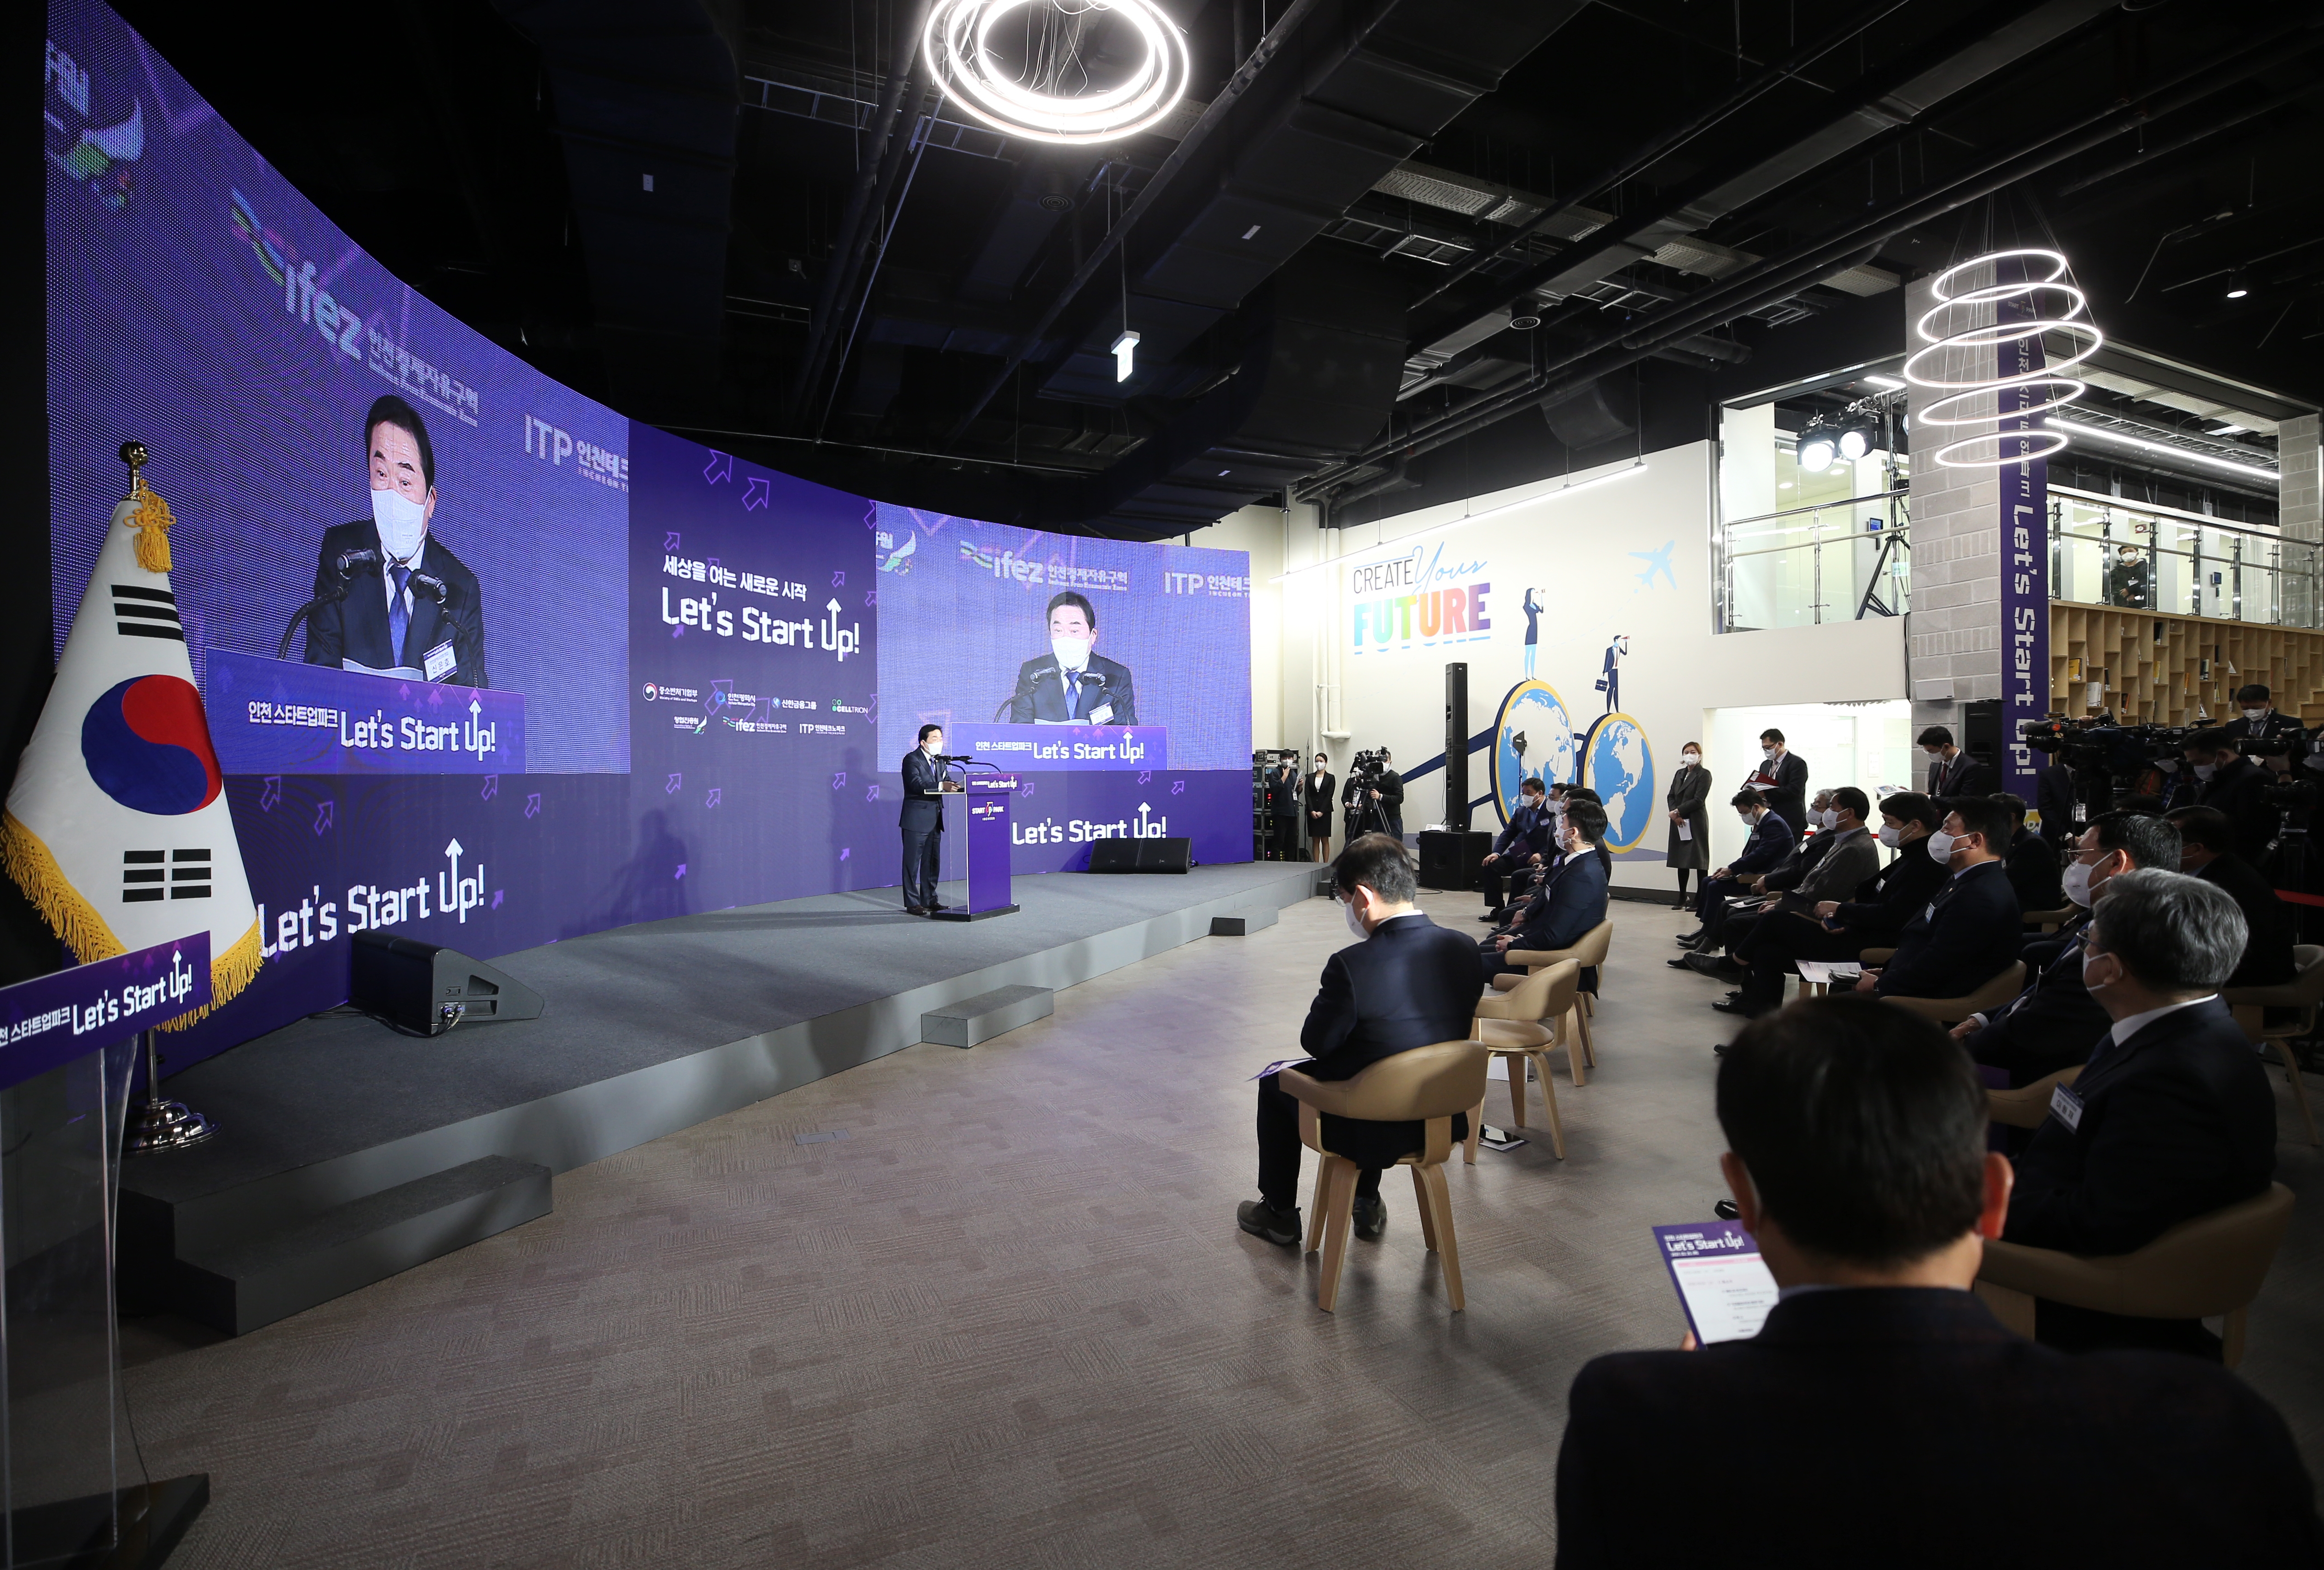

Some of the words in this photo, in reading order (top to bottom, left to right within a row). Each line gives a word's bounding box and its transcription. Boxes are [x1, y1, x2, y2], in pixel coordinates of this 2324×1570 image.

[286, 260, 362, 360] ifez
[525, 414, 573, 466] ITP
[2013, 504, 2037, 594] Let's
[663, 555, 706, 582] 세상을
[710, 565, 736, 588] 여는
[740, 572, 779, 597] 새로운
[782, 581, 807, 601] 시작
[995, 551, 1043, 583] ifez
[1354, 559, 1413, 593] CREATE
[1413, 541, 1487, 596] Your
[1165, 573, 1203, 594] ITP
[662, 586, 734, 637] Let's
[742, 606, 814, 648] Start
[821, 597, 859, 661] Up!
[1354, 582, 1491, 646] FUTURE
[2015, 607, 2035, 706] Start
[659, 686, 698, 697] 중소벤처기업부
[728, 693, 756, 703] 인천광역시
[782, 699, 817, 710] 신한금융그룹
[249, 701, 272, 723] 인천
[274, 704, 338, 728] 스타트업파크
[674, 716, 699, 724] 창업진흥원
[735, 718, 755, 732] ifez
[800, 724, 814, 734] ITP
[341, 709, 393, 748] Let's
[400, 716, 459, 751] Start
[465, 700, 496, 762] Up!
[975, 741, 990, 751] 인천
[991, 741, 1032, 751] 스타트업파크
[1033, 740, 1070, 759] Let's
[1074, 742, 1116, 759] Start
[1120, 732, 1144, 764] Up!
[988, 780, 998, 788] Let's
[1013, 817, 1063, 845] Let's
[1069, 819, 1127, 842] Start
[257, 885, 337, 957] Let's
[348, 877, 430, 934] Start
[439, 837, 484, 924] Up!
[73, 990, 118, 1035] Let's
[124, 977, 166, 1016] Start
[170, 950, 192, 1004] Up!
[11, 1007, 71, 1042] 스타트업파크
[1666, 1240, 1695, 1251] Let's
[1695, 1238, 1725, 1250] Start
[1725, 1230, 1744, 1250] Up!
